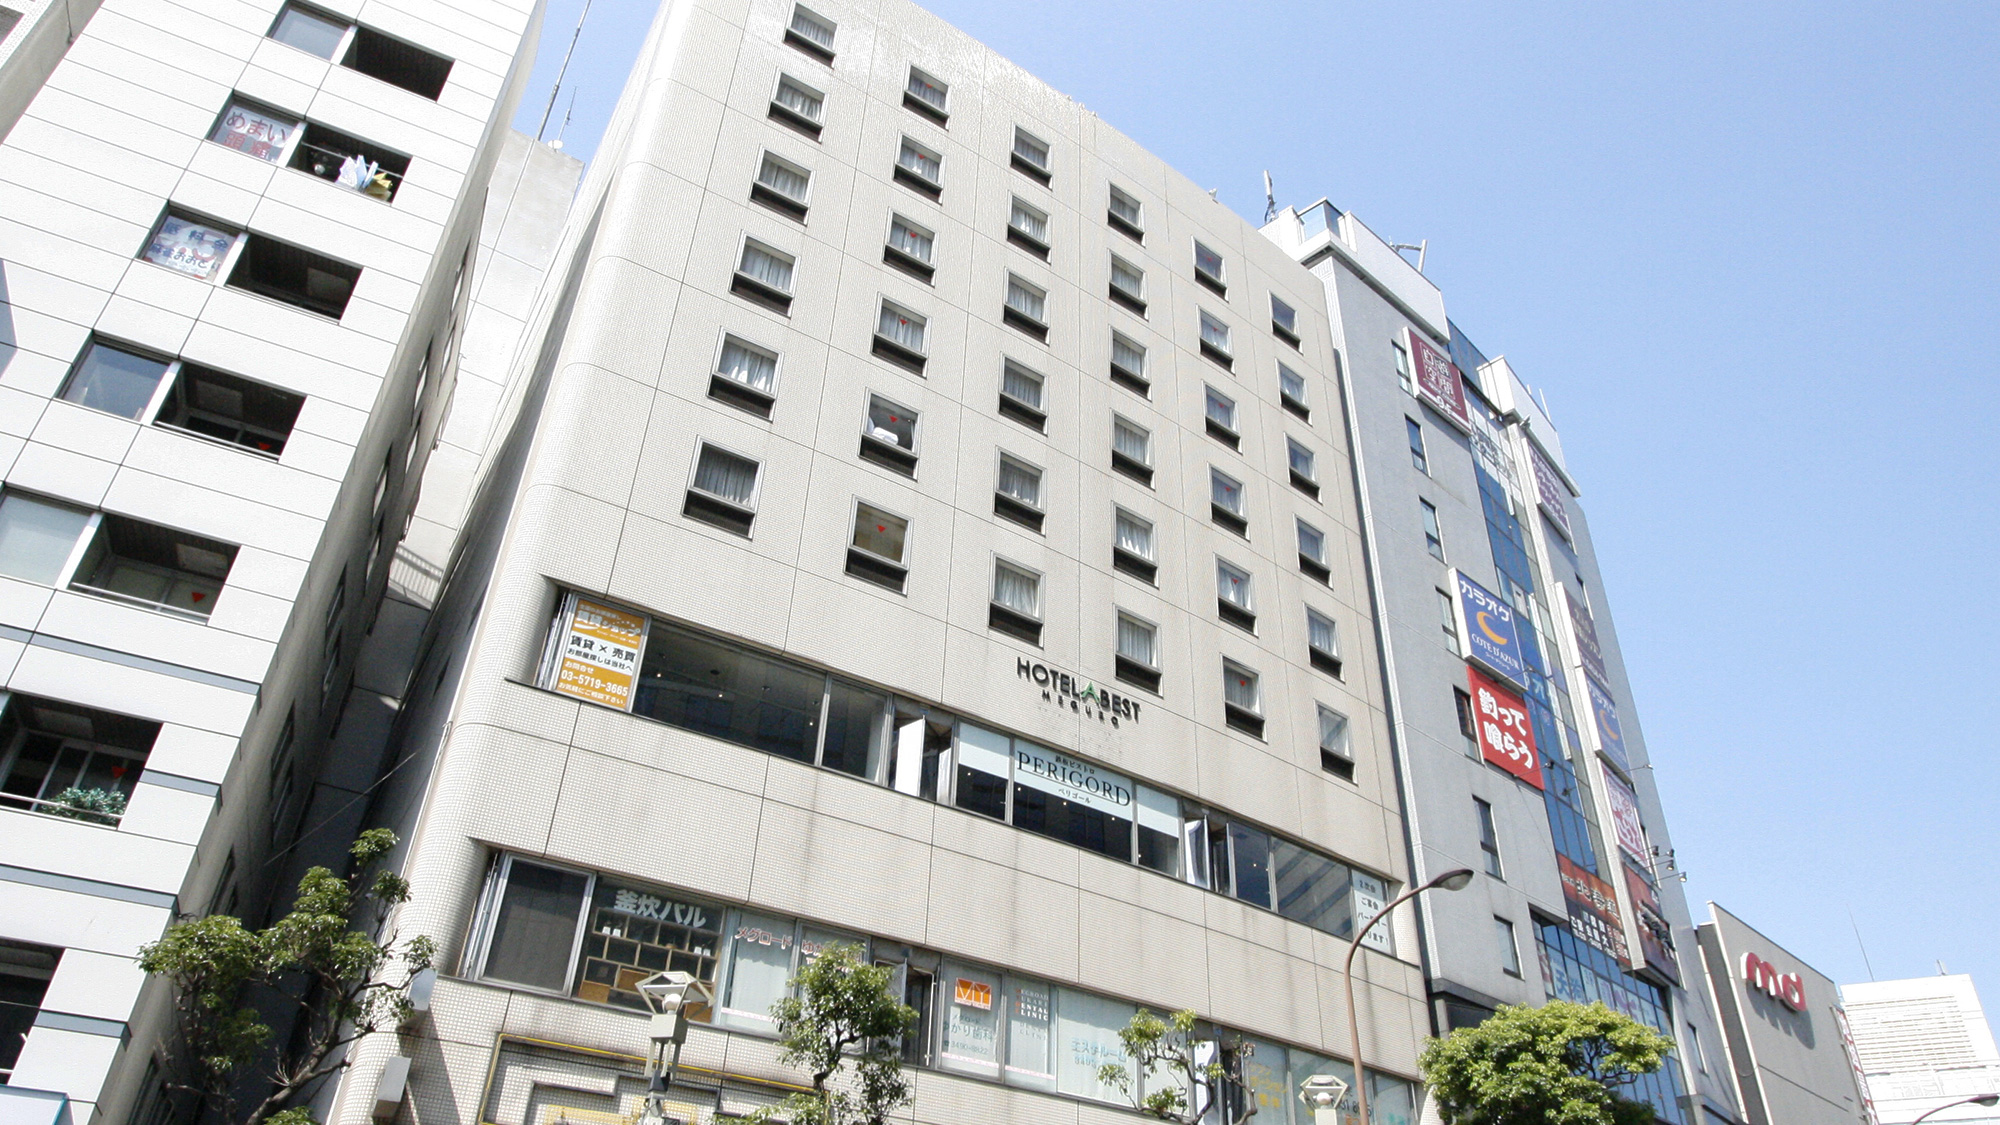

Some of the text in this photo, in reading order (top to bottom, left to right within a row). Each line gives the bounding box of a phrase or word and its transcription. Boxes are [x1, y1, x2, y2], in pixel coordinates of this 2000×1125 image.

[227, 111, 286, 142] めまい
[1460, 580, 1509, 622] カラオケ
[575, 610, 641, 637] 賃貸ショップ
[567, 648, 632, 672] お部屋探しは当社へ
[570, 635, 595, 651] 賃貸
[612, 648, 636, 663] 売買
[564, 660, 594, 675] お問合せ
[1017, 656, 1080, 700] HOTEL
[1041, 689, 1119, 729] MEGURO
[1478, 687, 1527, 736] 釣って
[1483, 721, 1533, 769] 喰らう
[1017, 750, 1131, 807] PERIGORD
[614, 889, 706, 928] 釜炊バル
[734, 926, 793, 950] メグロード
[943, 1020, 993, 1043] ゆかり歯科
